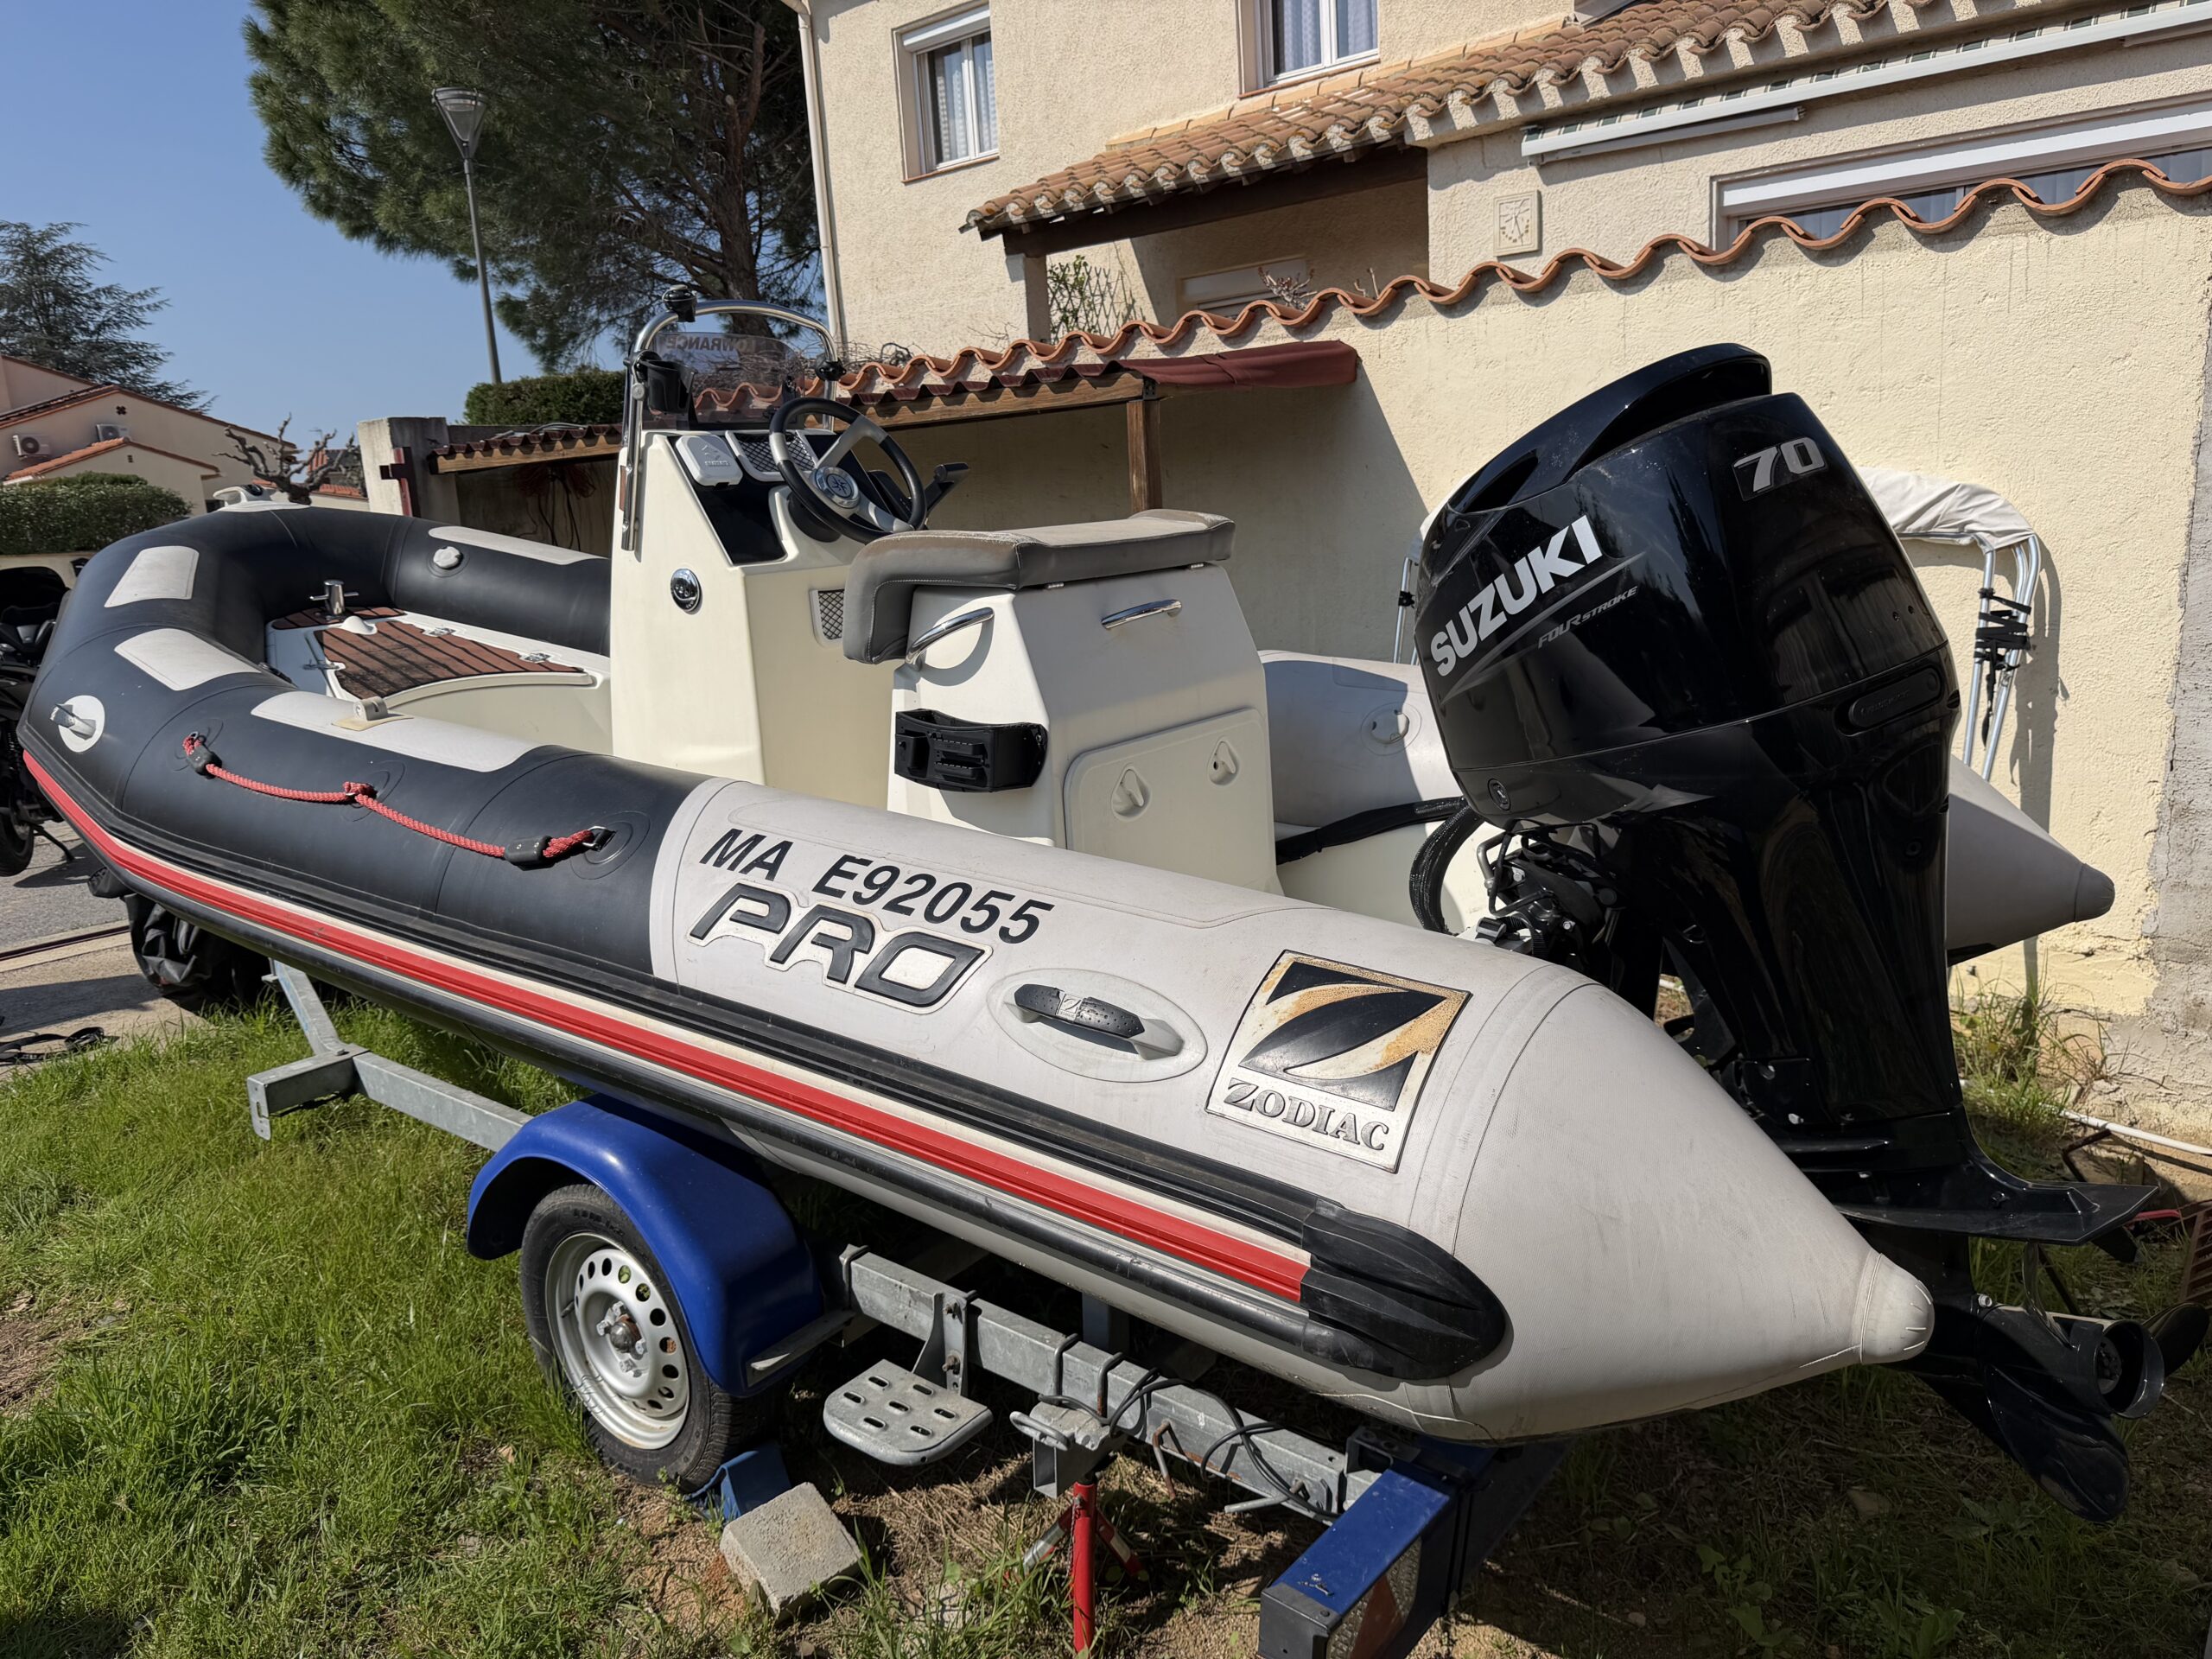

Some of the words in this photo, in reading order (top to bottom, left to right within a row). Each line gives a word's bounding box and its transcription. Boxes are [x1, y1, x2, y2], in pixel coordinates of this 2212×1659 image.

[1732, 436, 1826, 493] 70
[1431, 514, 1603, 677] SUZUKI
[699, 828, 794, 881] MA
[811, 854, 1056, 944] E92055
[689, 881, 987, 1009] PRO
[1224, 1077, 1389, 1151] ZODIAC
